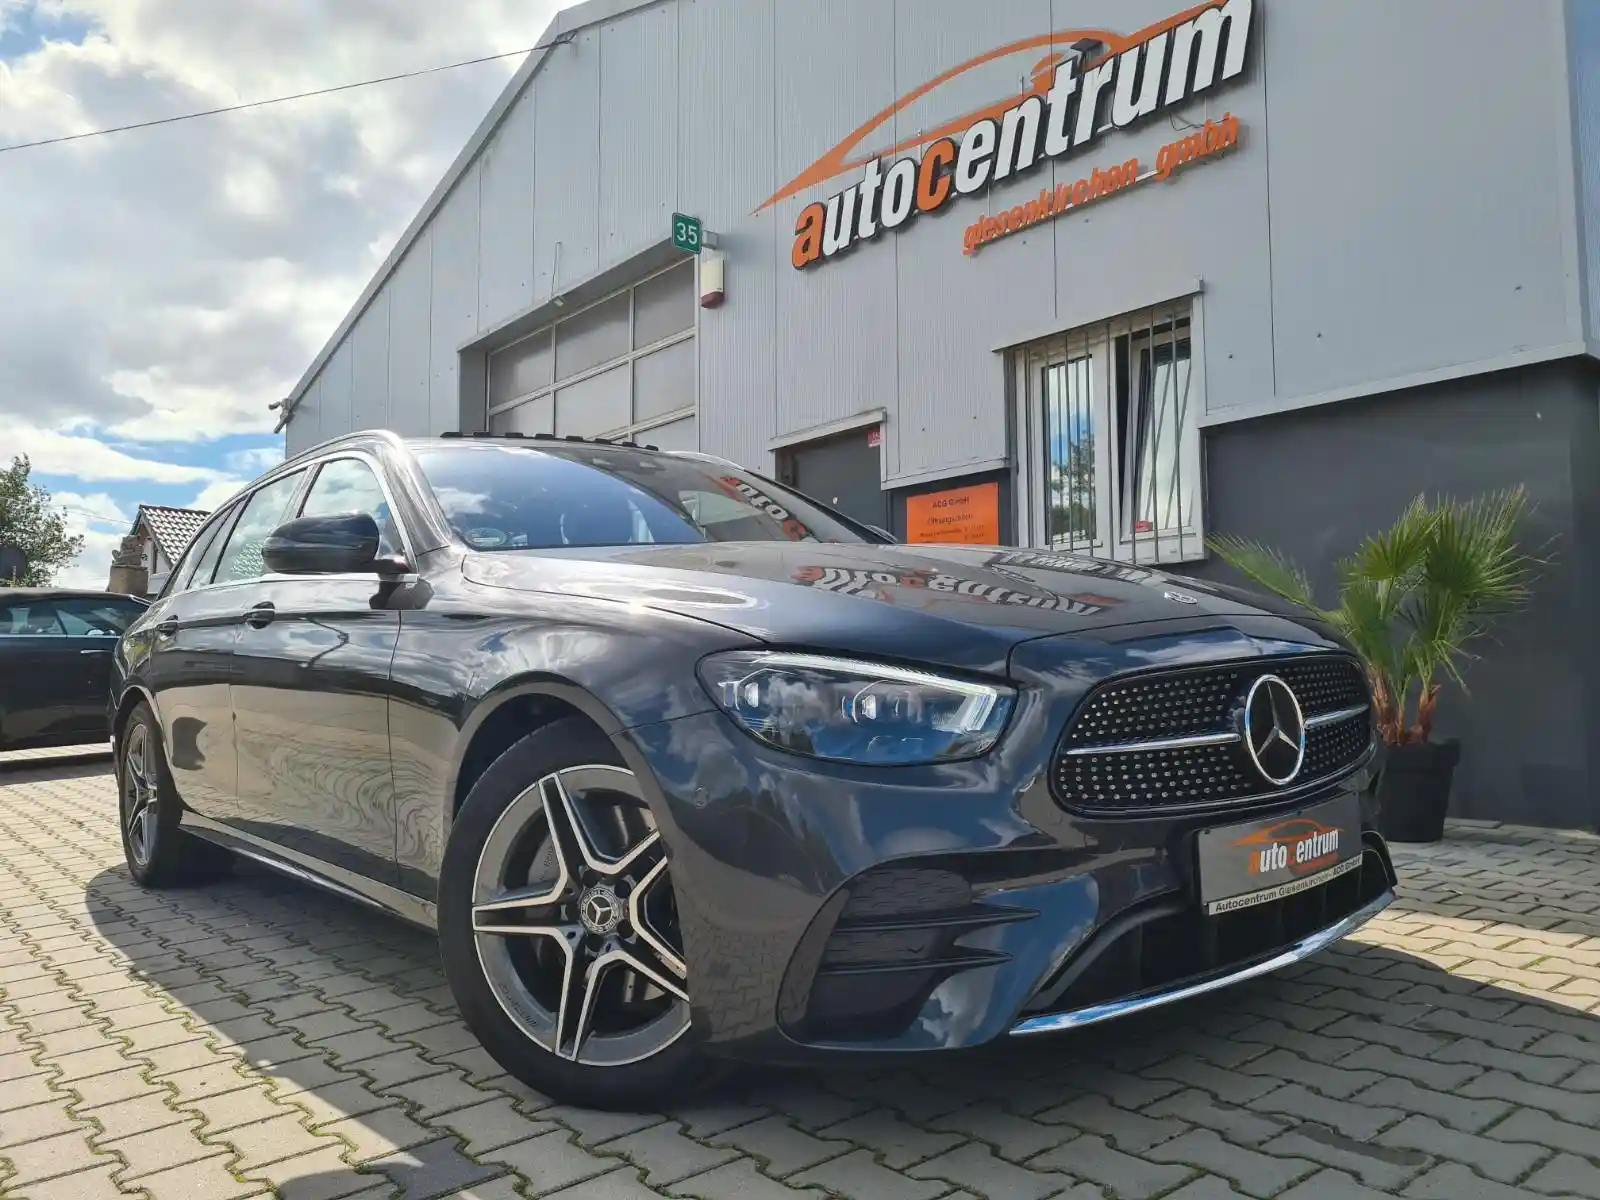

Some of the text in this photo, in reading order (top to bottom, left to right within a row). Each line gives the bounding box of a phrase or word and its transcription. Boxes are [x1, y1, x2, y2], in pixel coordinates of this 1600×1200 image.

[792, 0, 1253, 270] autocentrum
[962, 112, 1240, 256] giesenkirchen gmbh
[676, 222, 698, 245] 35
[1248, 829, 1339, 876] autocentrum
[1215, 891, 1277, 913] Autocentrum
